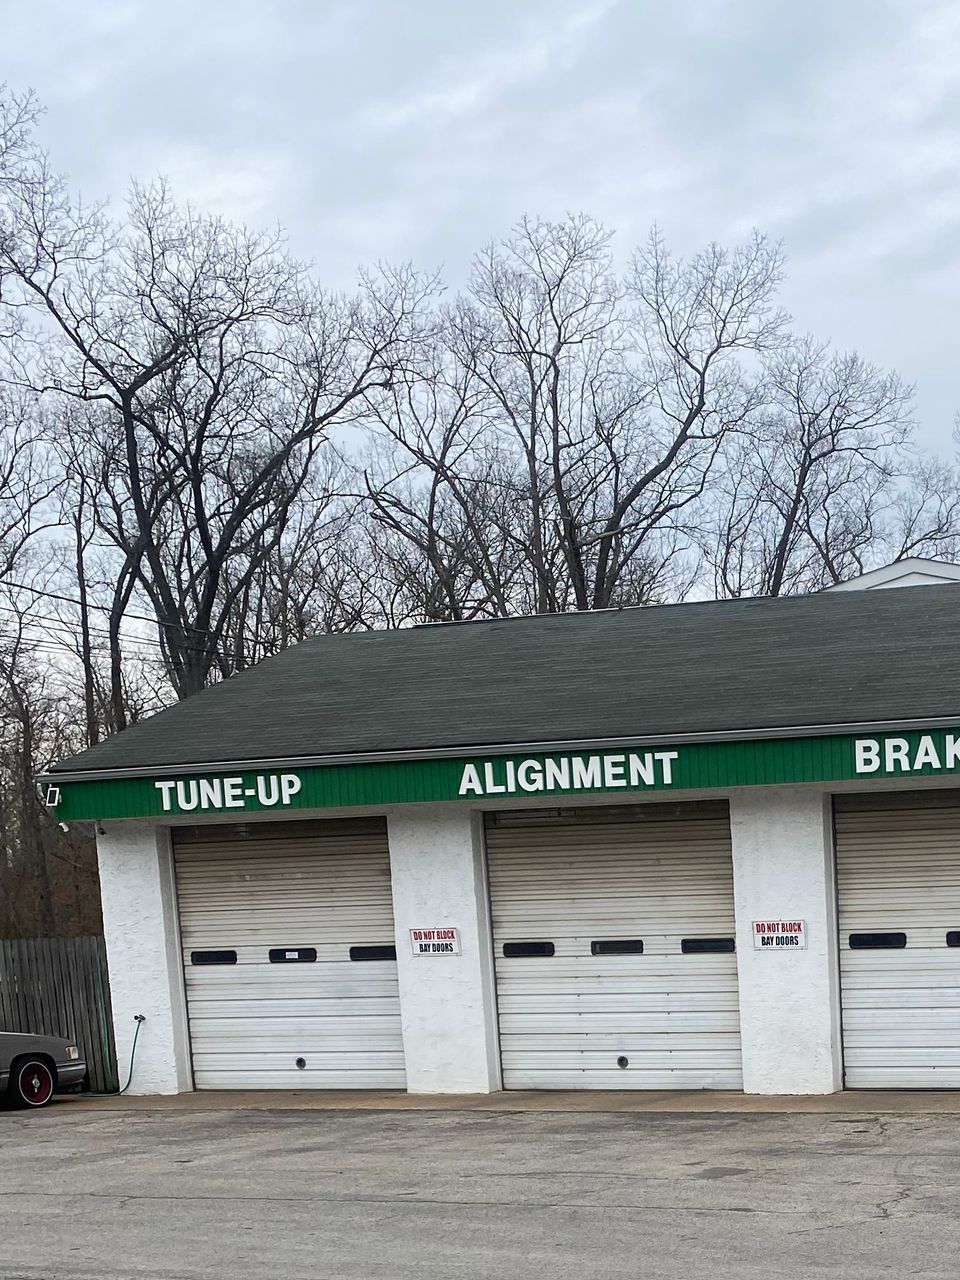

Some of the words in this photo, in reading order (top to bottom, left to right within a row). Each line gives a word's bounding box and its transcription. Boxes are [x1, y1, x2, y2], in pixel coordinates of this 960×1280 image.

[458, 751, 678, 796] ALIGNMENT
[154, 774, 302, 811] TUNE-UP
[756, 923, 766, 933] DO
[766, 922, 780, 933] NOT
[781, 922, 802, 933] BLOCK
[413, 931, 423, 941] DO
[423, 930, 435, 940] NOT
[436, 930, 456, 940] BLOCK
[761, 936, 774, 946] BAY
[775, 935, 799, 946] DOORS
[419, 943, 431, 953] BAY
[432, 943, 454, 953] DOORS
